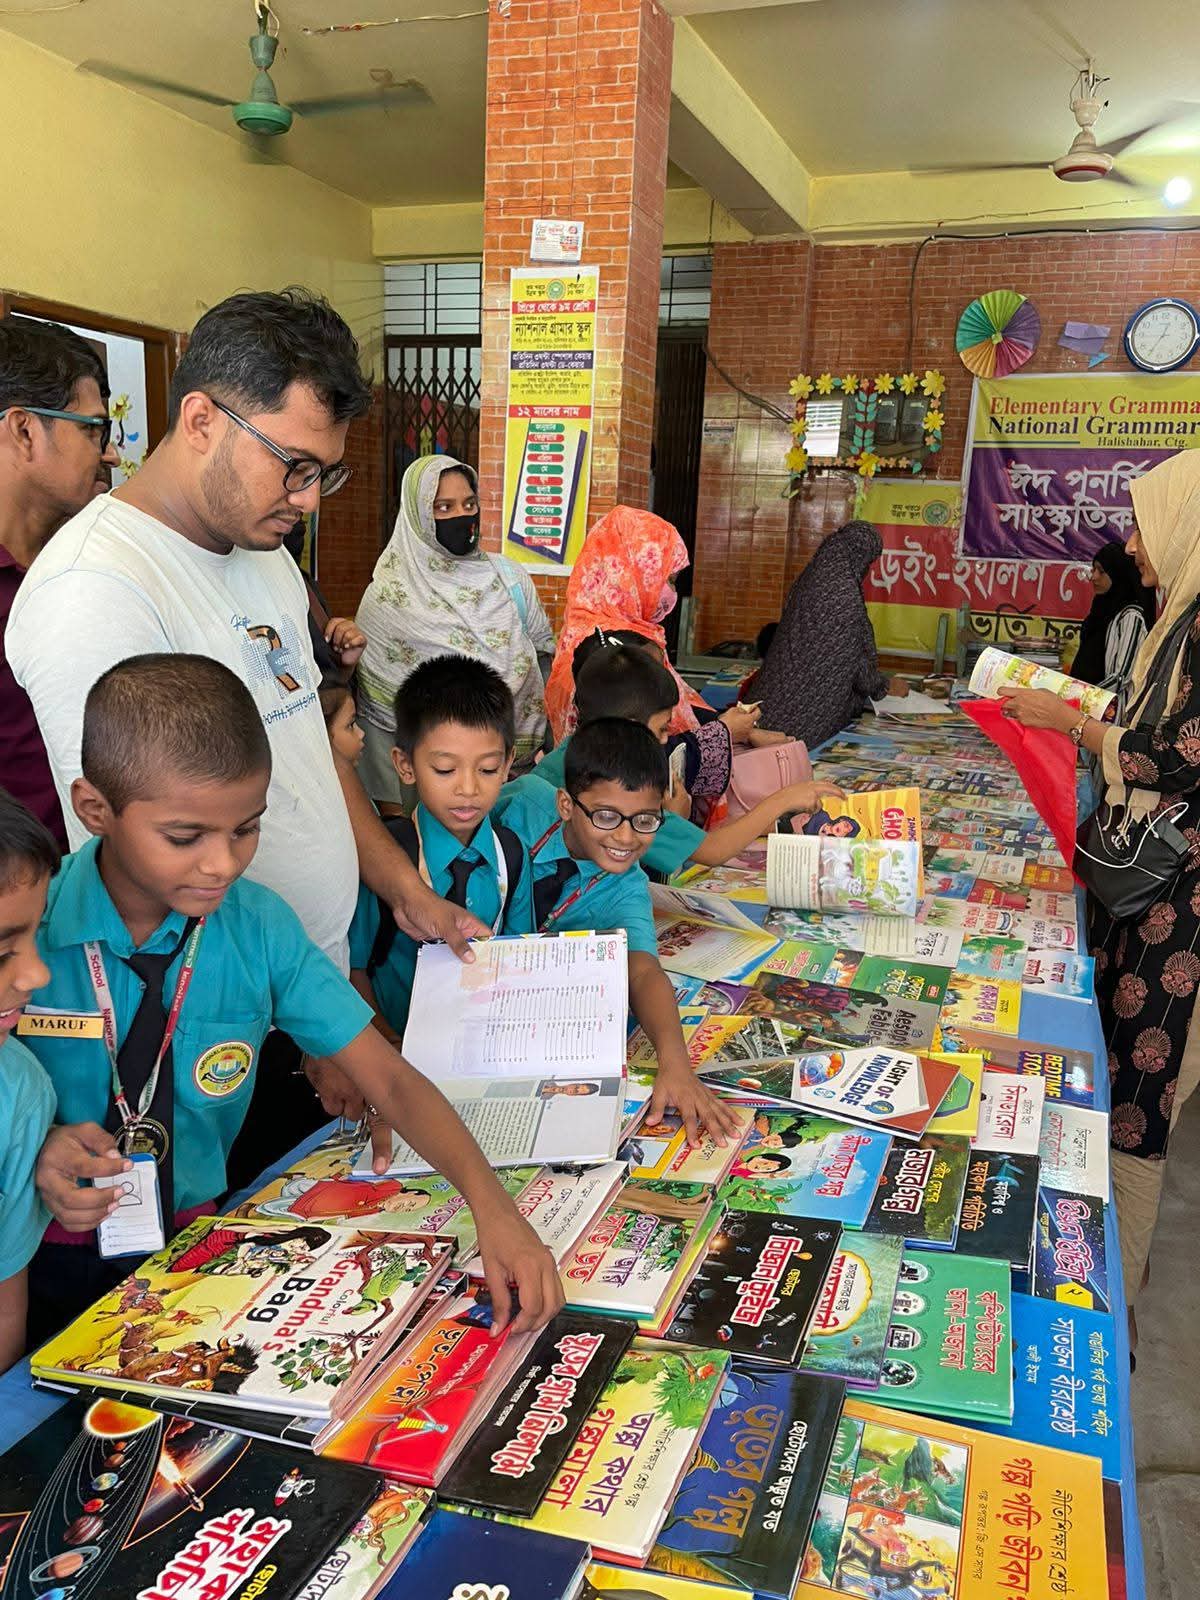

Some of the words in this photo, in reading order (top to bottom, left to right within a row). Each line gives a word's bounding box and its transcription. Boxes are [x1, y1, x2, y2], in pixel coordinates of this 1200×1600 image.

[537, 302, 557, 312] থেকে
[515, 322, 548, 336] ন্যাশনাল
[549, 322, 574, 335] গ্রামার
[576, 322, 592, 338] স্কুল
[518, 407, 531, 416] ১২
[533, 407, 561, 416] মাসের
[563, 407, 579, 416] নাম
[990, 396, 1100, 416] Elementary
[1109, 395, 1200, 415] Gramma
[989, 416, 1079, 435] National
[1085, 415, 1200, 435] Grammar
[1164, 437, 1188, 449] Ctg.
[1008, 461, 1057, 496] ঈদ
[996, 498, 1135, 544] সাংস্কৃতিক
[89, 953, 105, 989] School
[30, 1017, 88, 1031] MARUF
[839, 1054, 893, 1106] KNOWLEDGE
[874, 1085, 894, 1099] OF
[1044, 1053, 1064, 1098] BEDTIME
[894, 1149, 935, 1188] মজার
[967, 1159, 989, 1193] মহাকাশ
[814, 1178, 845, 1198] গল্প
[881, 1186, 923, 1214] গল্প
[990, 1179, 1012, 1207] মহাবিশ্ব
[960, 1193, 987, 1232] পরিচিতি
[565, 1247, 607, 1286] ভূত
[751, 1234, 803, 1284] বিজ্ঞান
[245, 1276, 315, 1328] Bag
[261, 1257, 358, 1354] Grandma's
[318, 1287, 354, 1327] Colorful
[728, 1283, 779, 1327] কুইজ
[939, 1288, 967, 1369] জানা-অজানা
[1050, 1318, 1074, 1371] সাতজন
[551, 1334, 604, 1380] ভূতের
[1026, 1344, 1041, 1363] আলী
[1087, 1332, 1106, 1365] বাঙালির
[530, 1373, 577, 1411] গ্রাম
[1025, 1364, 1038, 1384] ইমাম
[1048, 1375, 1087, 1437] বীরশ্রেষ্ঠ
[1091, 1384, 1105, 1405] ভাষা
[611, 1414, 655, 1452] অল্প
[1089, 1409, 1112, 1436] শহিদ
[489, 1406, 563, 1481] নিলামে
[542, 1405, 617, 1512] গল্পমালা
[578, 1457, 633, 1519] কথার
[1000, 1458, 1035, 1487] গল্প
[685, 1484, 757, 1538] গল্প
[757, 1506, 782, 1533] যত
[995, 1492, 1041, 1532] পড়ি
[1048, 1489, 1072, 1561] নীতিশিক্ষার
[972, 1559, 983, 1580] সাগর
[996, 1535, 1042, 1592] জীবন
[1047, 1563, 1075, 1594] শ্রেষ্ঠ
